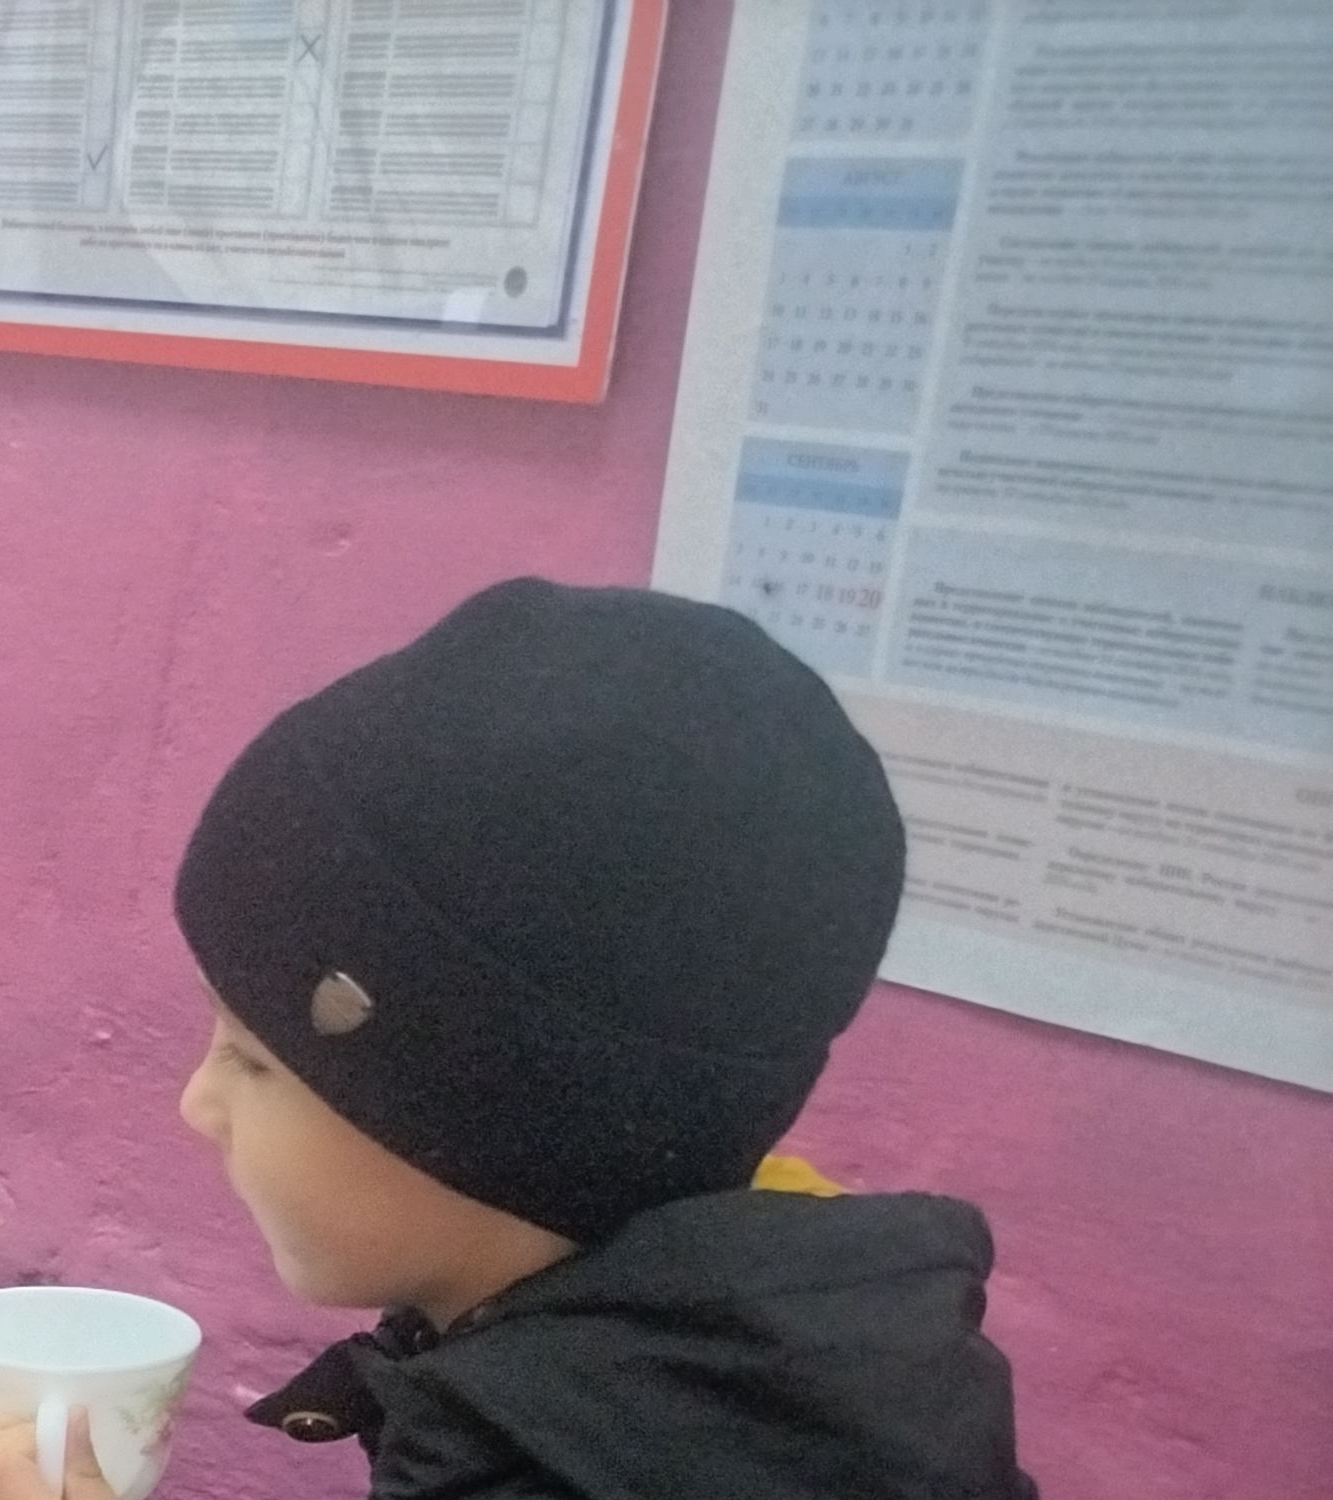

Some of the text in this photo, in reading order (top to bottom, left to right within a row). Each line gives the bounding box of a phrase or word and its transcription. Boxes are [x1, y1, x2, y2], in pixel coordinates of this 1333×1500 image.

[815, 583, 836, 602] 18
[838, 586, 857, 605] 19
[856, 588, 883, 610] 20
